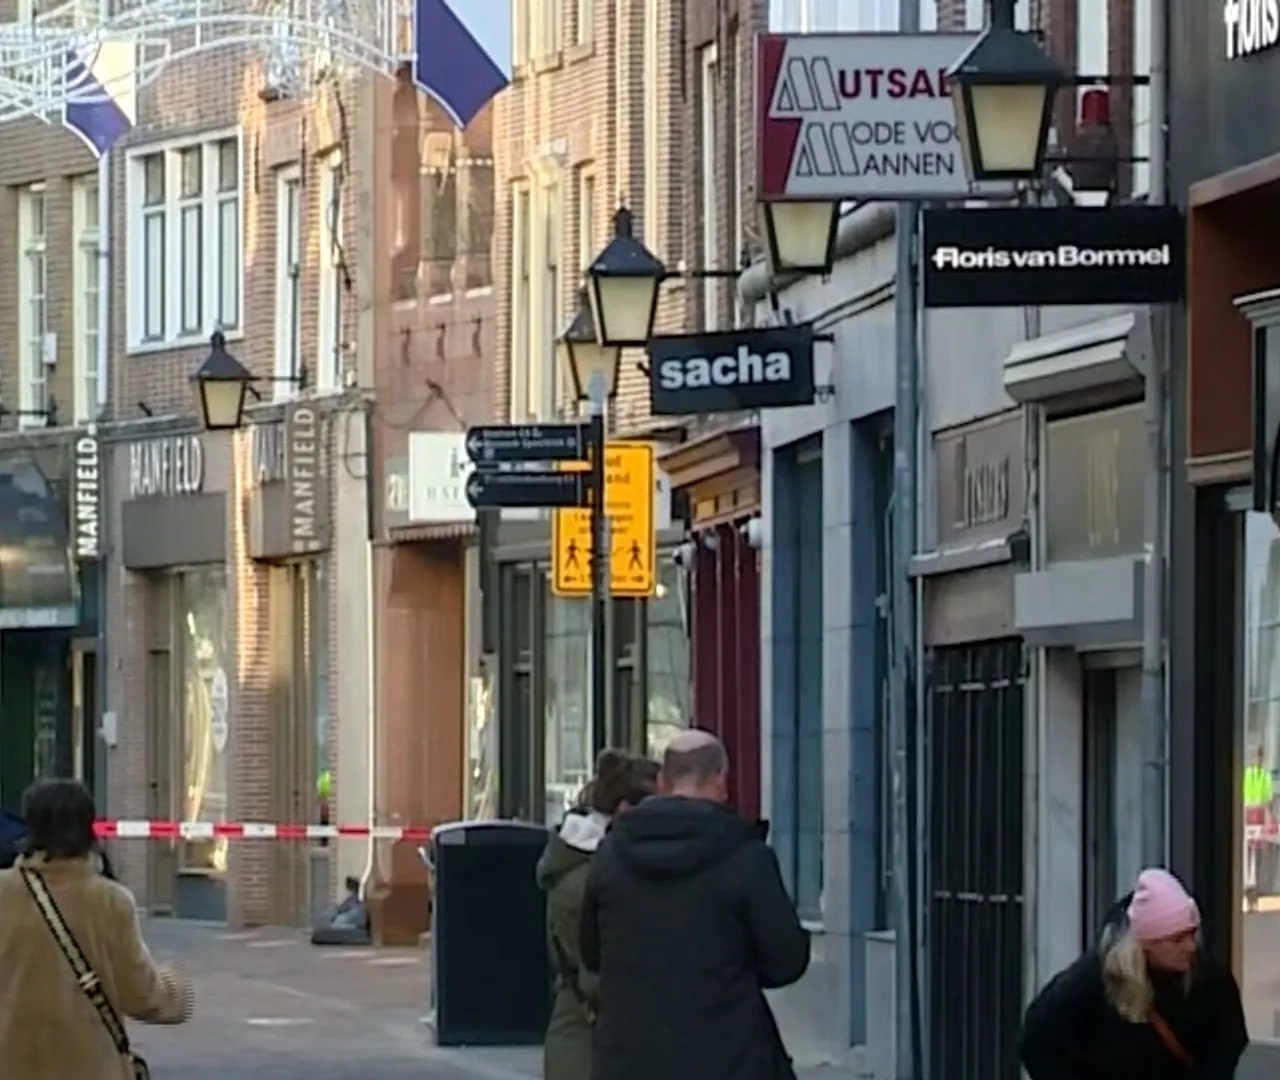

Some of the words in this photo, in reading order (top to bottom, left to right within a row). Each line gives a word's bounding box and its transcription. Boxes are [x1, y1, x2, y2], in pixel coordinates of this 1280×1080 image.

[914, 121, 960, 145] VO
[660, 345, 791, 390] sacha
[77, 437, 99, 557] MANFIELD
[130, 436, 204, 497] MANFIELD
[293, 407, 316, 537] MANFIELD
